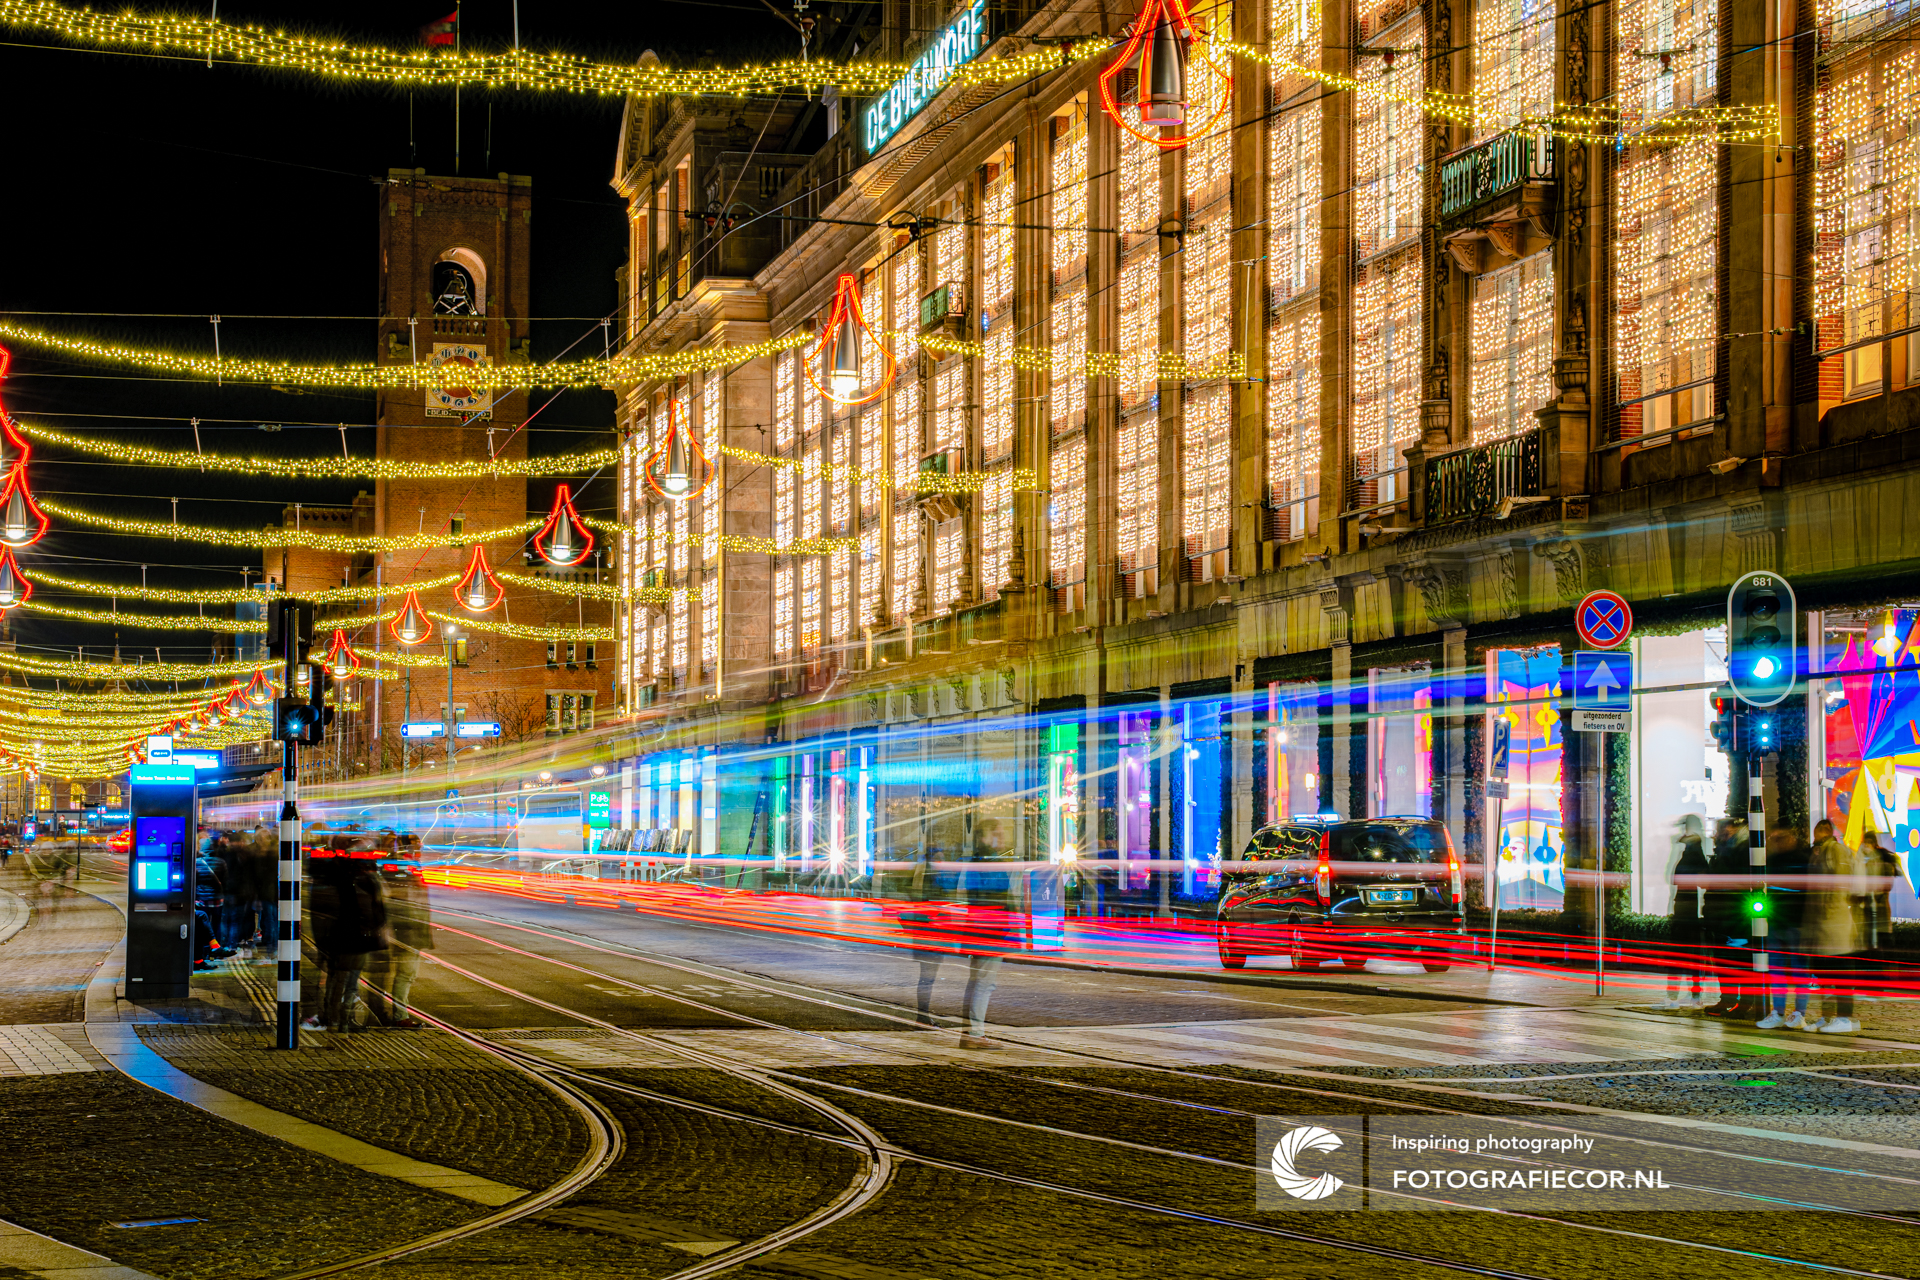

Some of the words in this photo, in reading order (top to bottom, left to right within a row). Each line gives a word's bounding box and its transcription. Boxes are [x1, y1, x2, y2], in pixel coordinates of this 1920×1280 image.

[867, 95, 888, 149] DE
[1752, 577, 1772, 587] 681
[1583, 711, 1622, 720] uitgezonderd
[1583, 722, 1606, 730] fietsers
[1616, 722, 1625, 730] OV
[1495, 724, 1506, 749] P
[590, 794, 597, 802] P
